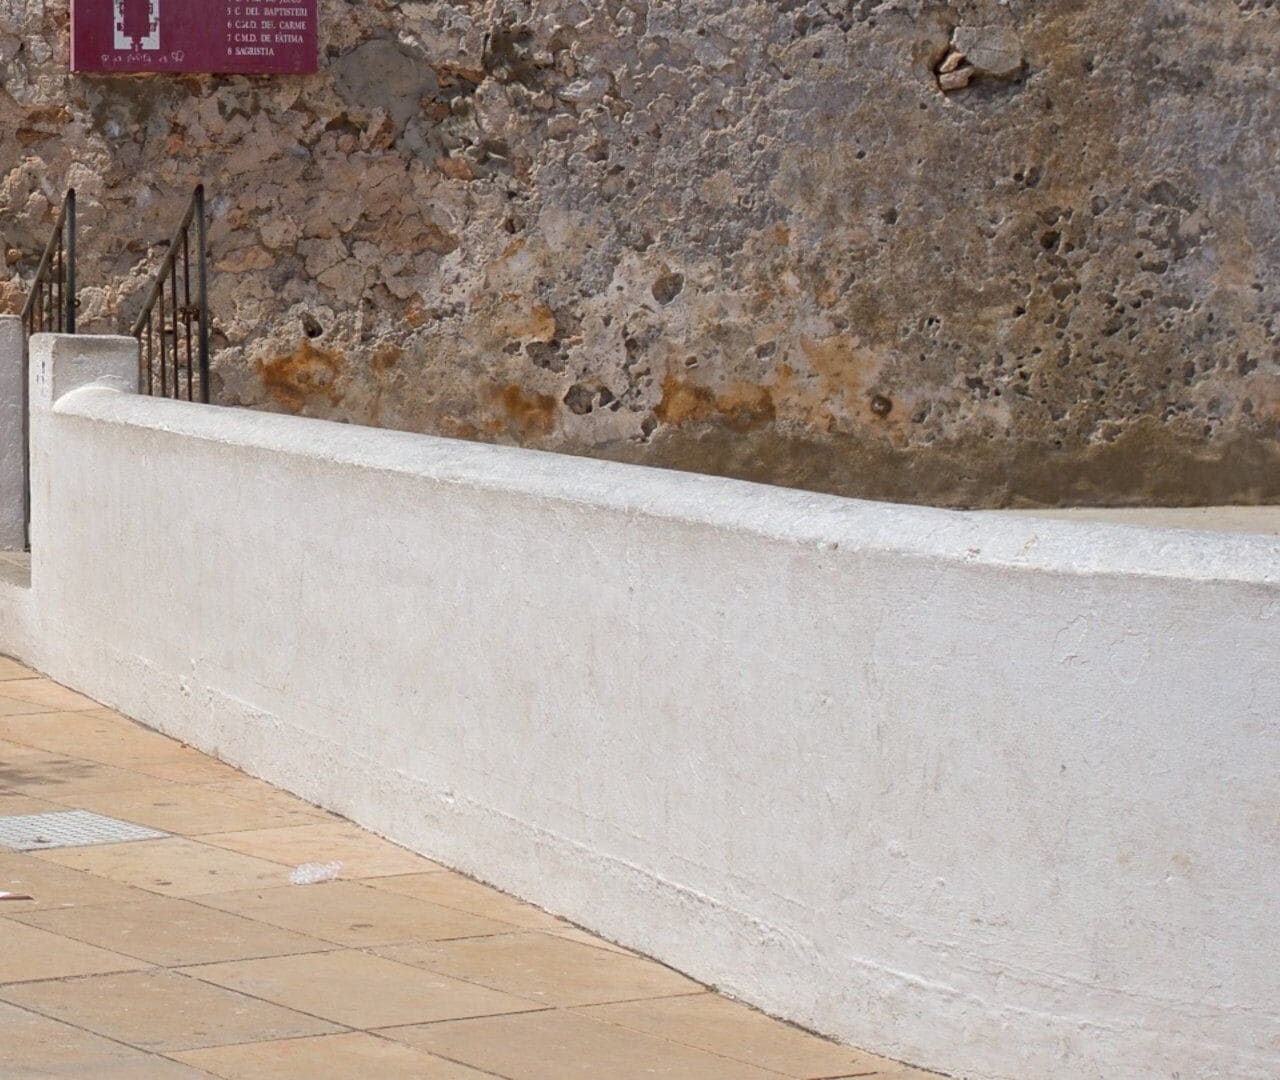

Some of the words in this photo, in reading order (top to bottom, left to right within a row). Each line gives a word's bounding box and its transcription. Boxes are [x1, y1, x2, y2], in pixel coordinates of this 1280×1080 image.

[245, 7, 260, 16] DEL
[264, 7, 308, 16] BAPTISTERI
[279, 21, 307, 30] CARME
[260, 34, 271, 42] DE
[235, 47, 275, 56] SAGRISTIA
